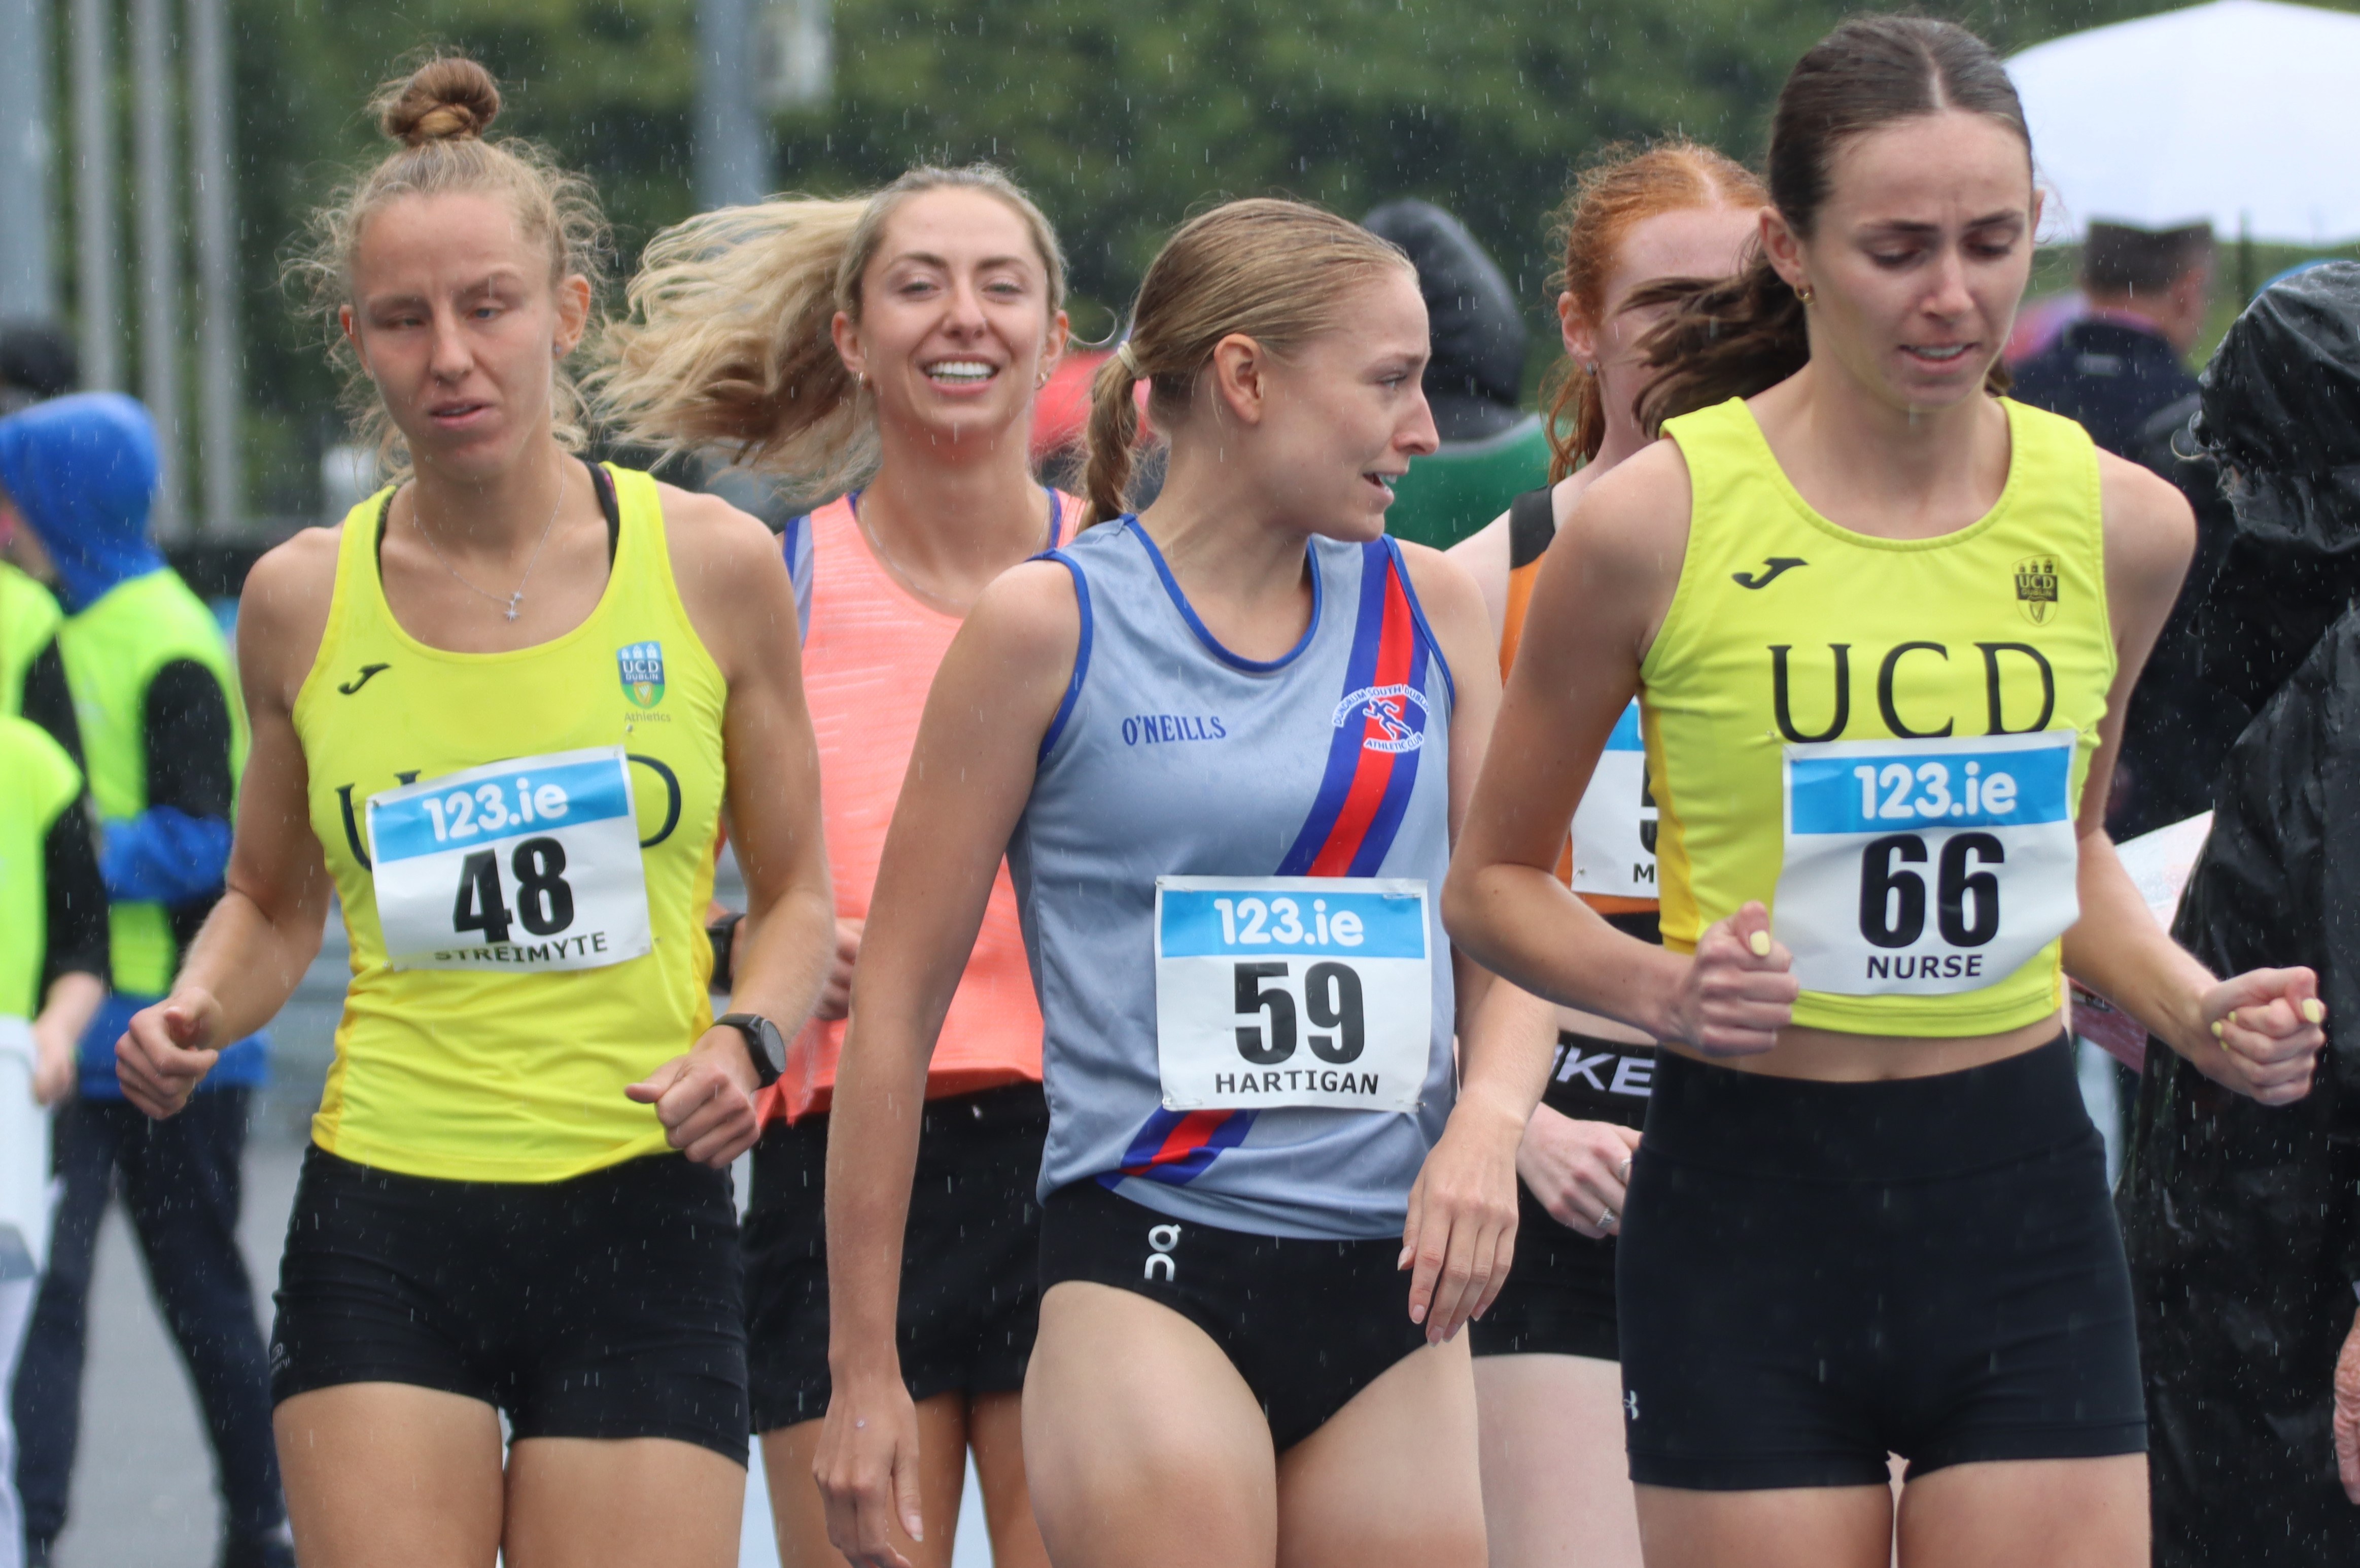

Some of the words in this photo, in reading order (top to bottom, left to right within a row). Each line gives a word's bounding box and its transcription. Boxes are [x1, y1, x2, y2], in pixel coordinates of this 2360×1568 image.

[2019, 574, 2054, 588] UCD
[622, 660, 660, 674] UCD
[1766, 641, 2056, 744] UCD
[624, 711, 671, 722] Athletics
[1122, 715, 1226, 746] O'NEILLS
[423, 778, 568, 842] 123.ie
[1854, 761, 2018, 820] 123.ie
[453, 837, 575, 944] 48
[1858, 832, 2004, 949] 66
[1214, 897, 1364, 947] 123.ie
[435, 931, 608, 962] STREIMYTE
[1866, 954, 1983, 979] NURSE
[1233, 961, 1365, 1065] 59
[1216, 1070, 1379, 1096] HARTIGAN
